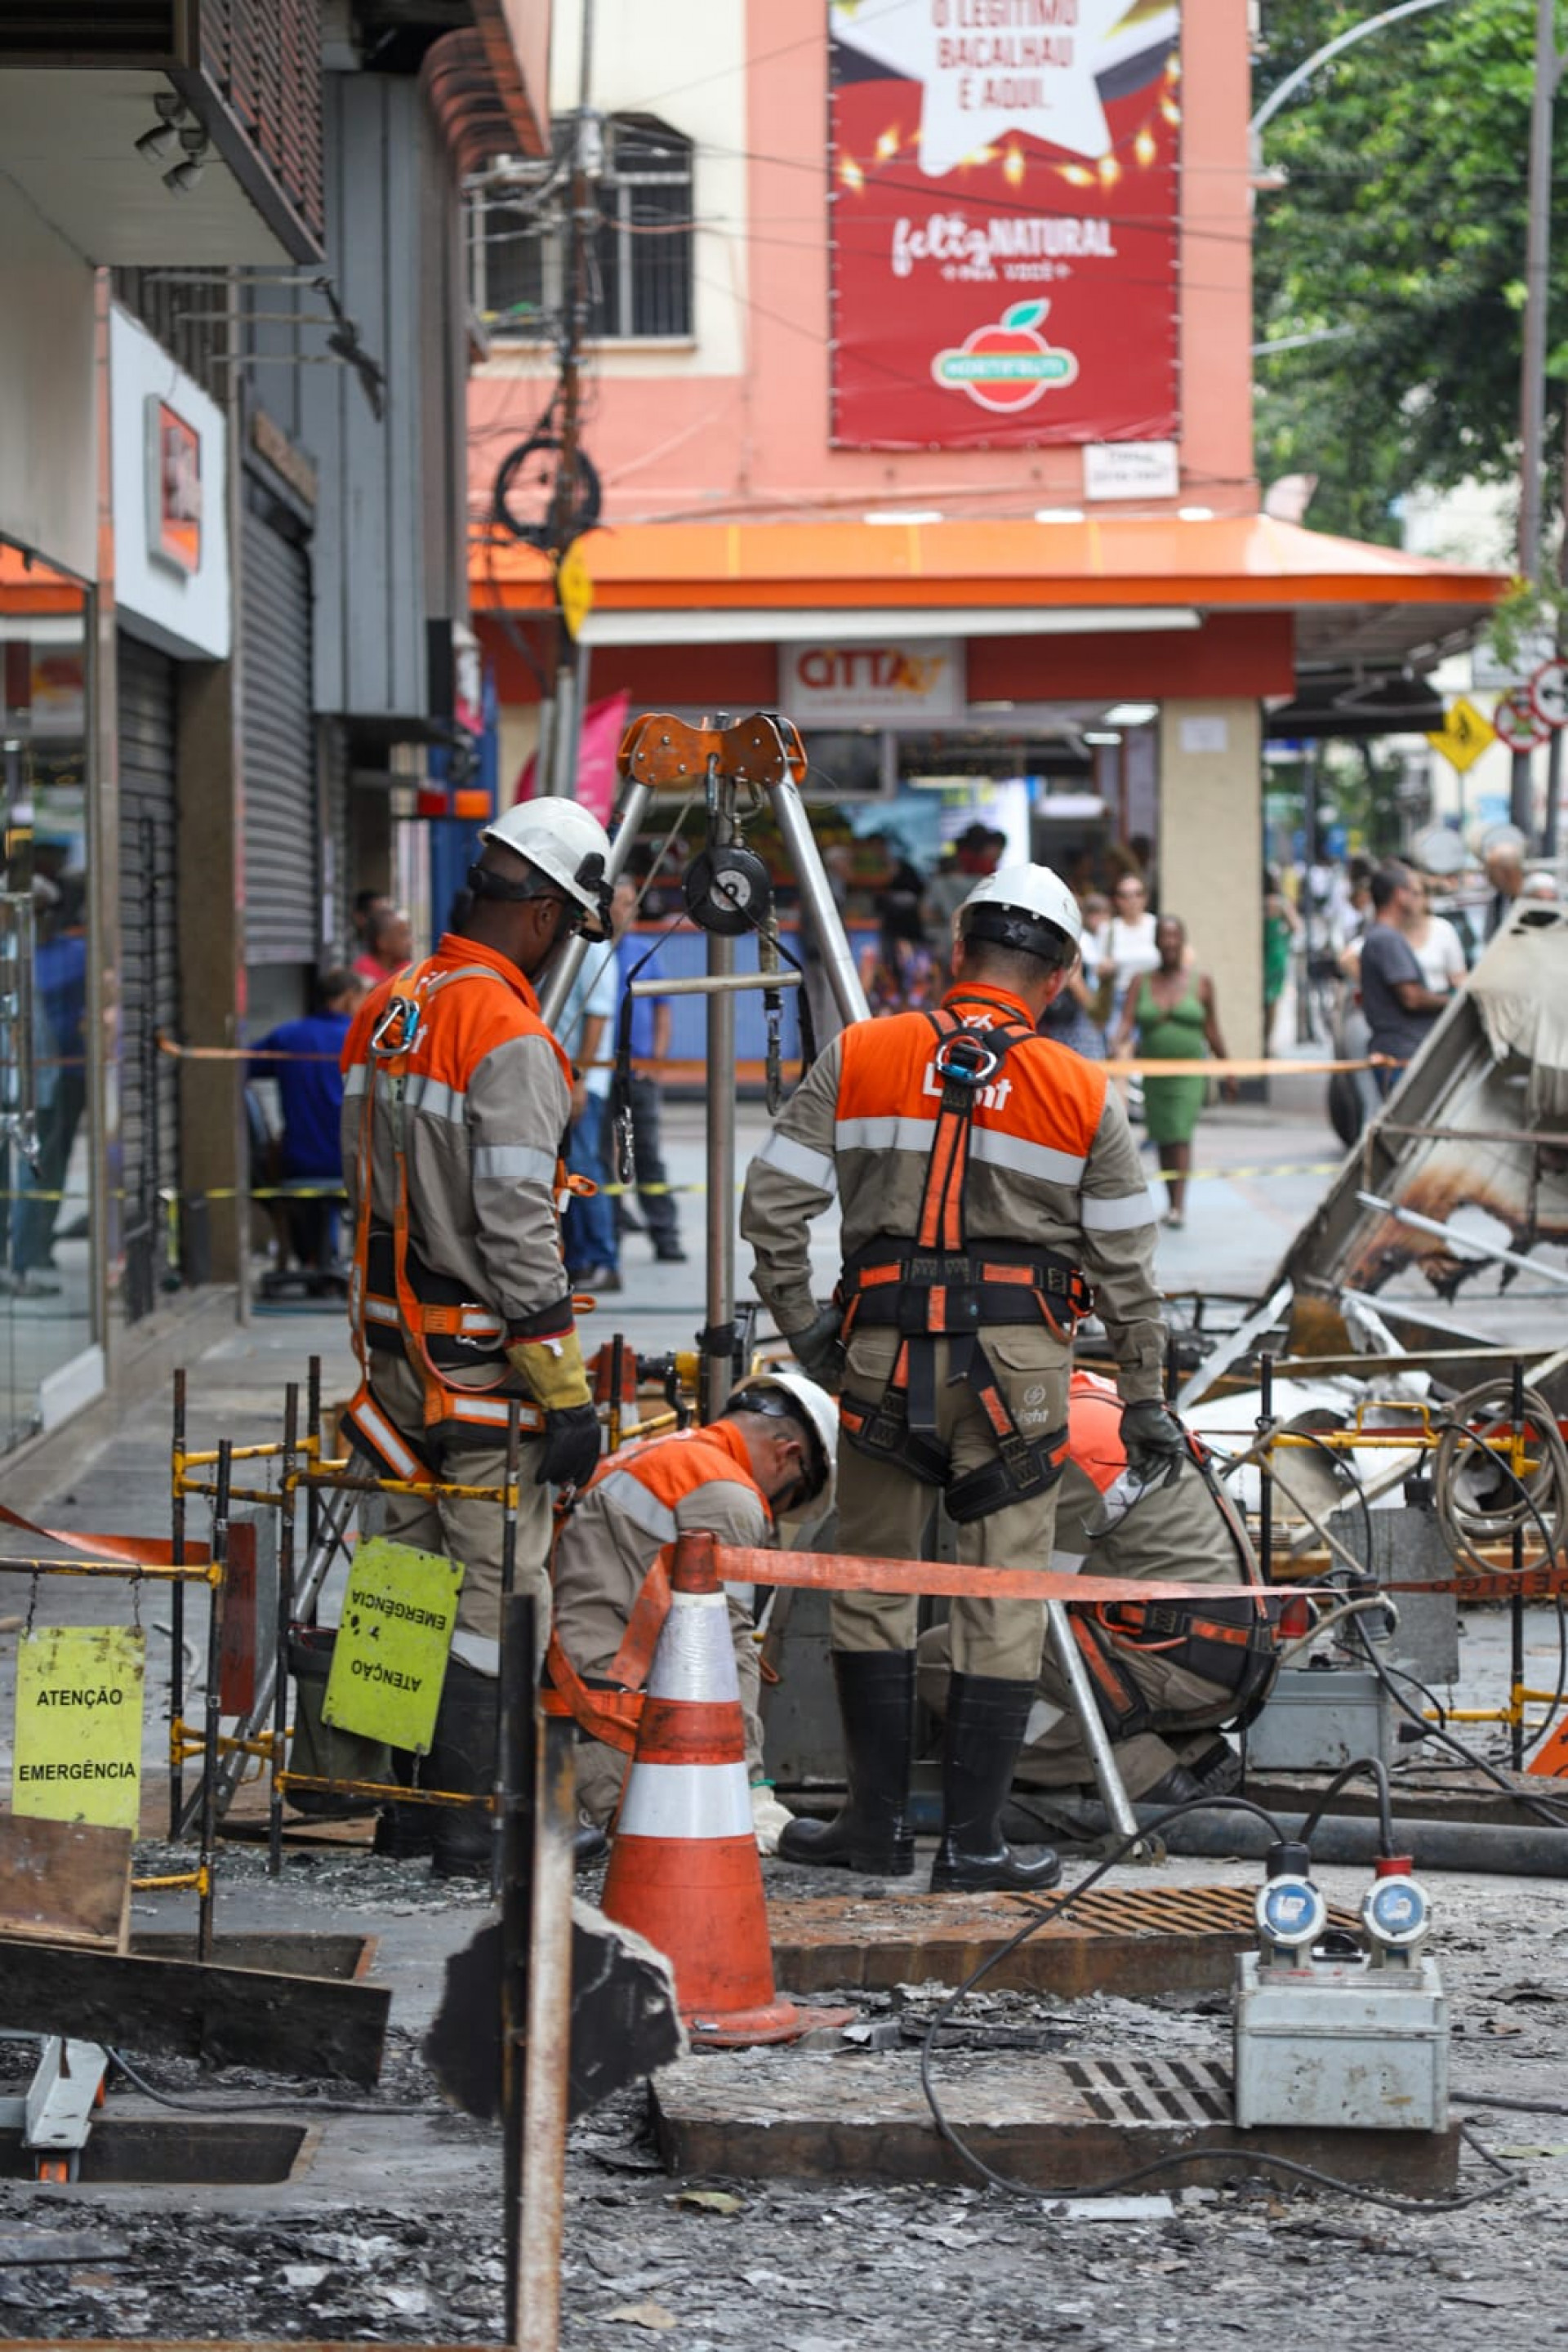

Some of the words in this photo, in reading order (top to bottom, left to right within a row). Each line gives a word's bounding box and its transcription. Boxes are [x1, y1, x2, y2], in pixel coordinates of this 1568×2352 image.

[938, 37, 1073, 68] BACALHAU
[959, 71, 972, 109] É
[893, 212, 990, 278] feliz
[988, 217, 1117, 257] NATURAL
[923, 1062, 1013, 1111] Lht
[351, 1589, 448, 1630] EMERGÊNCIA
[351, 1659, 422, 1692] ATENÇÃO
[36, 1686, 123, 1708] ATENÇÃO
[19, 1759, 136, 1780] EMERGÊNCIA
